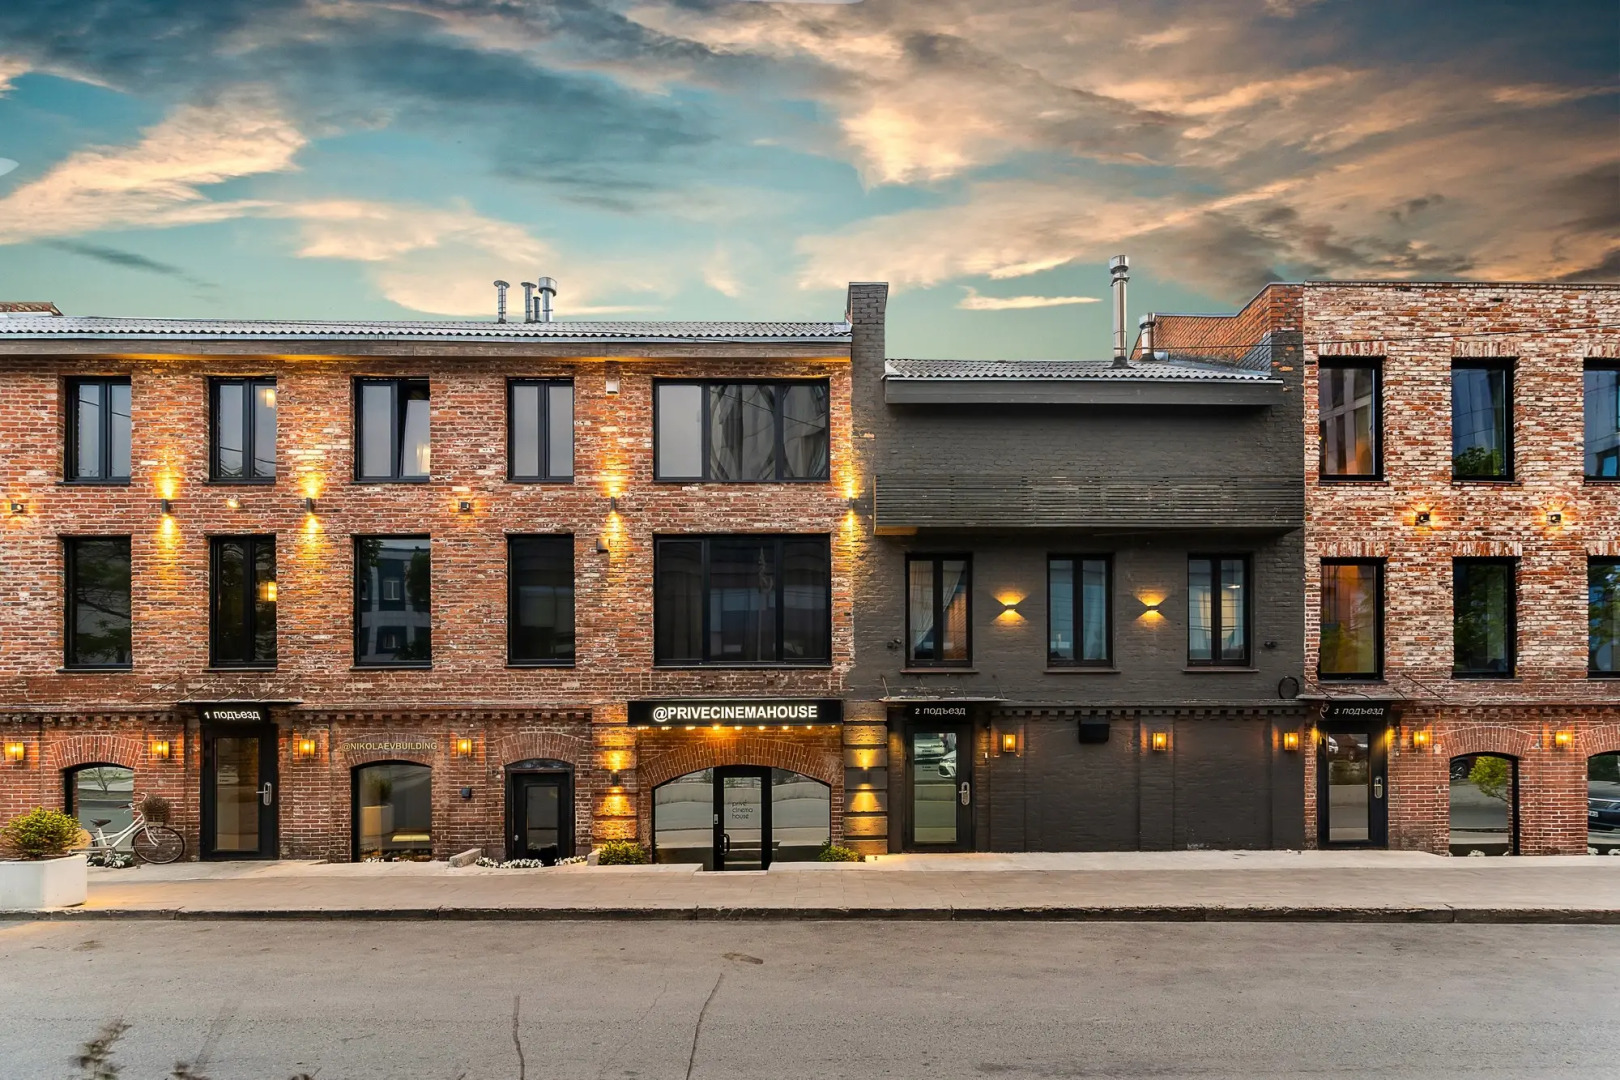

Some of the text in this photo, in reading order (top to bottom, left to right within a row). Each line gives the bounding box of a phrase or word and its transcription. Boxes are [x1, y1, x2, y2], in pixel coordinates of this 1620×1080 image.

[204, 711, 261, 720] 1 подъезд
[653, 706, 818, 722] @PRIVECINEMAHOUSE
[923, 707, 966, 716] подъезд
[1342, 707, 1384, 716] подъезд
[341, 742, 438, 752] @NIKOLAEVBUILDING
